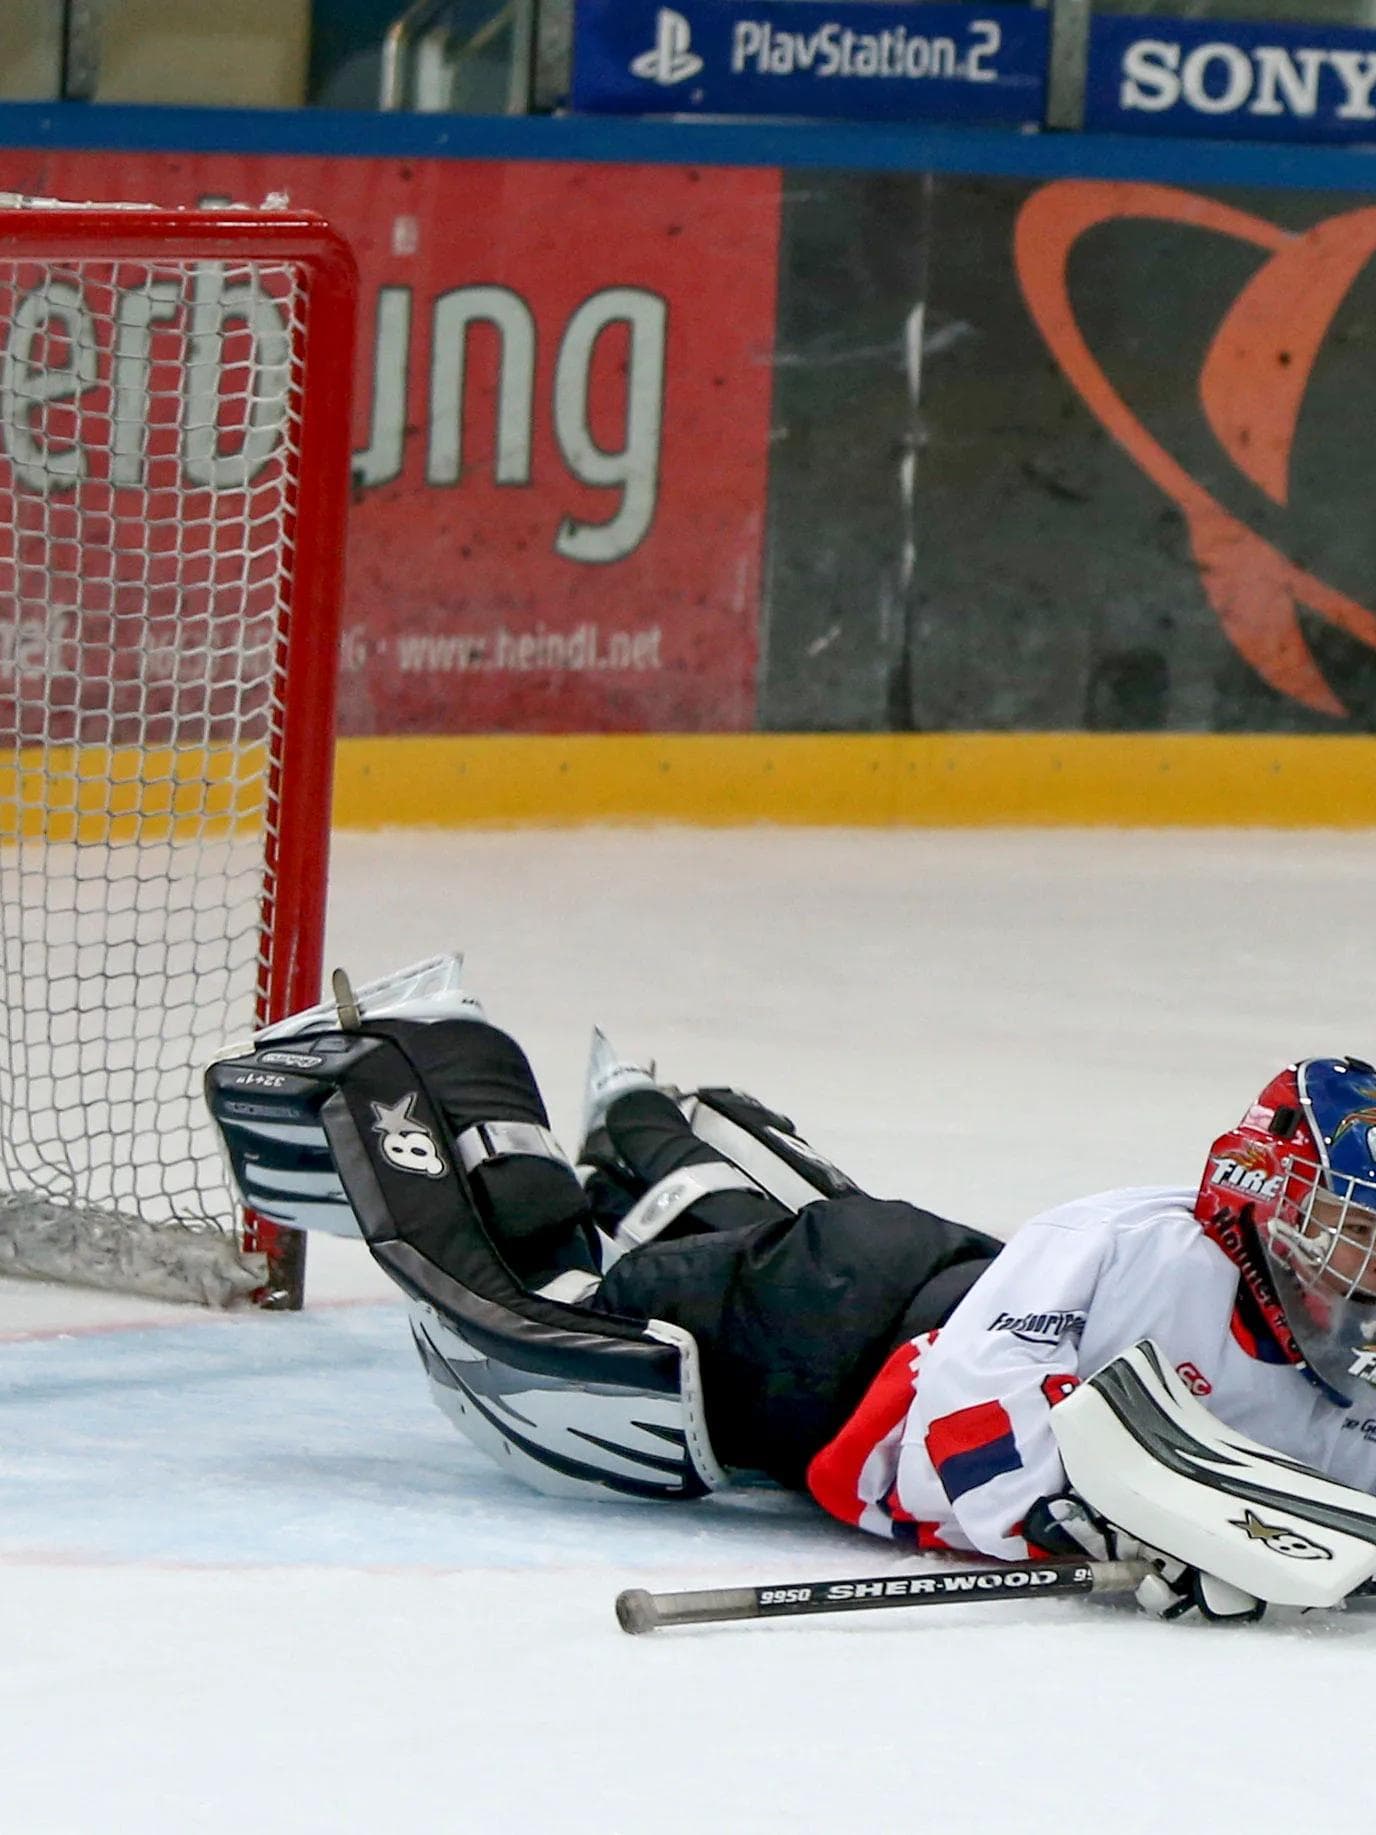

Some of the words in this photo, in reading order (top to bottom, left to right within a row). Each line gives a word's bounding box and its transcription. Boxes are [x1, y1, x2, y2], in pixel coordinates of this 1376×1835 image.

[397, 624, 662, 672] www.heindl.net
[759, 1587, 810, 1606] 9950
[827, 1569, 1058, 1600] SHER-WOOD
